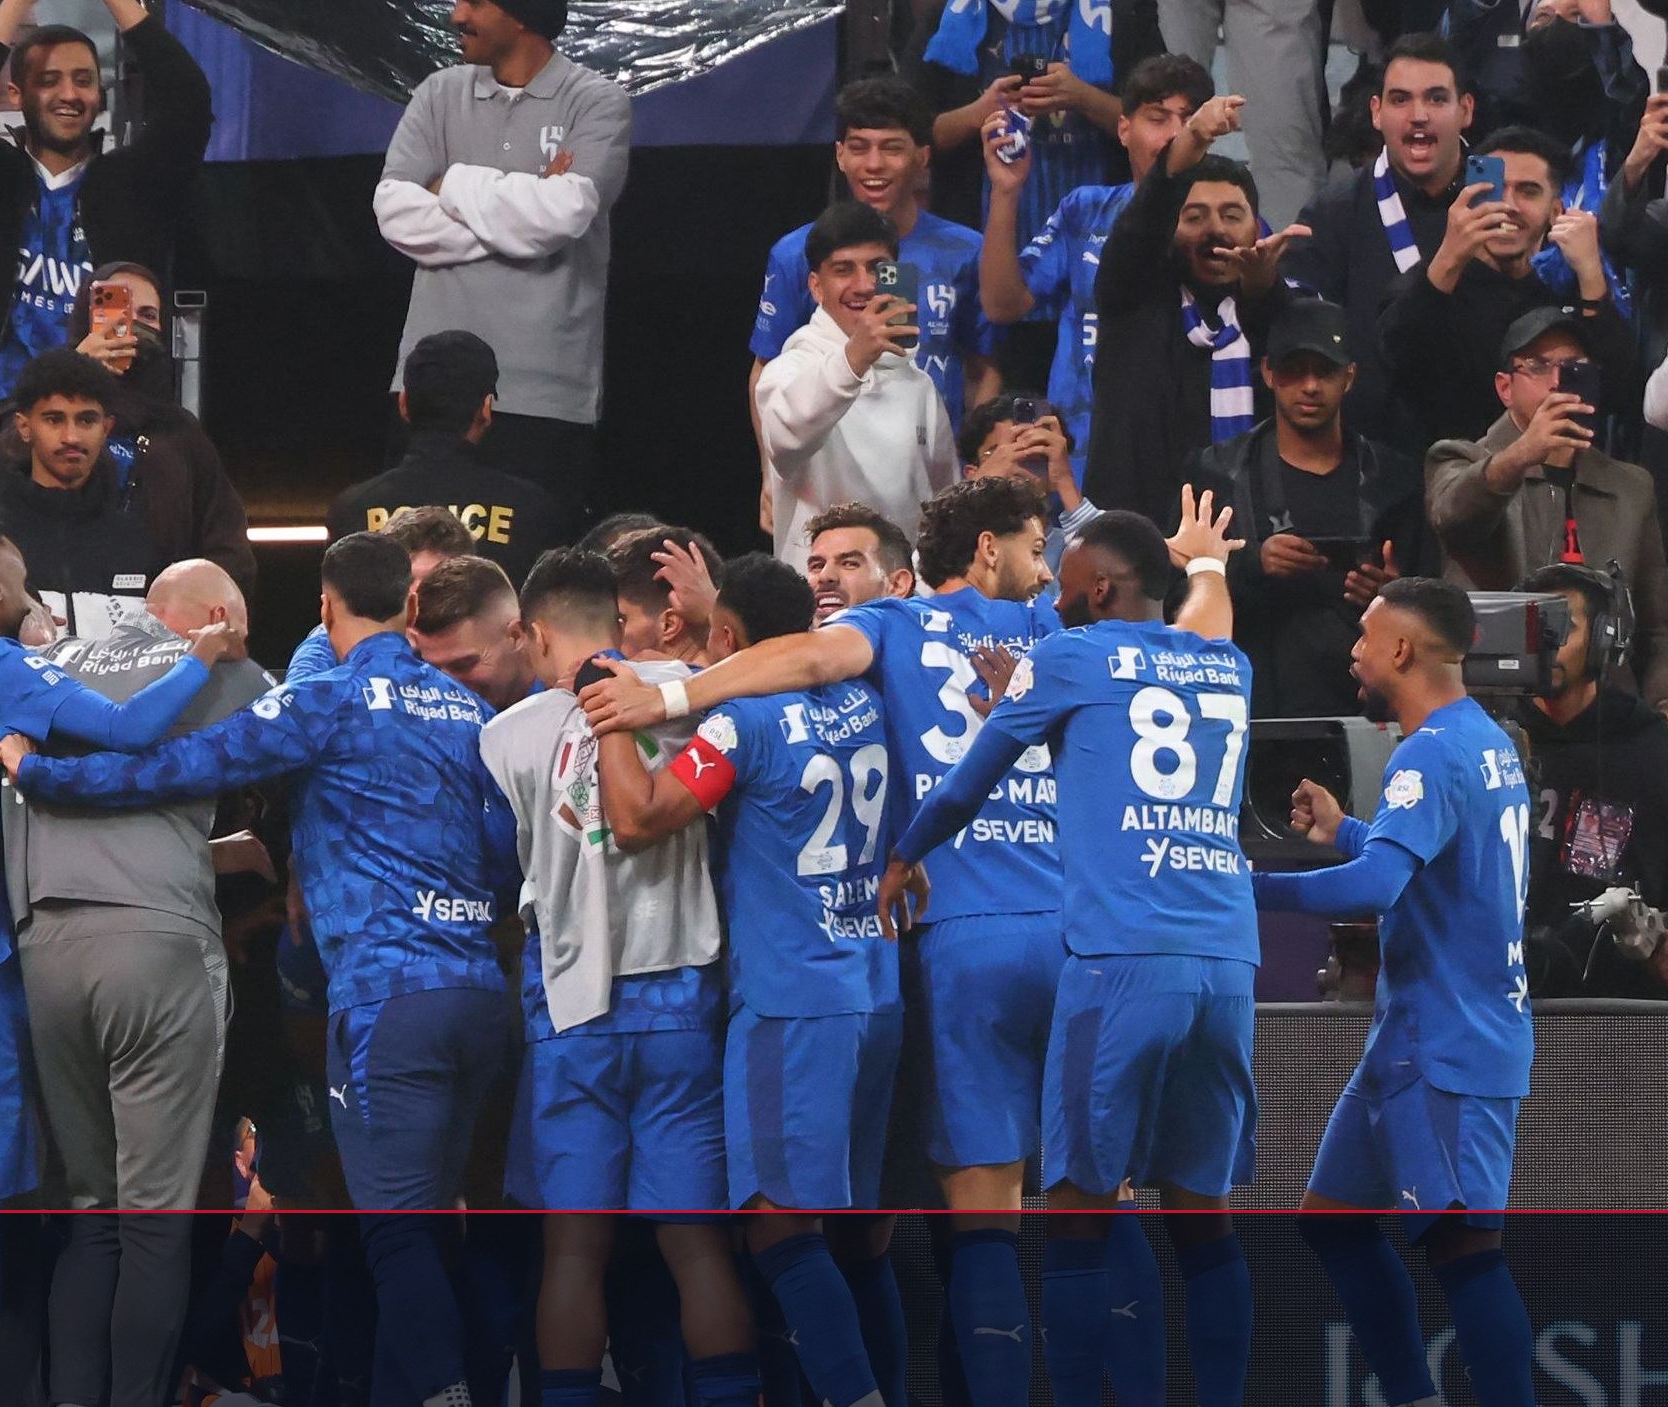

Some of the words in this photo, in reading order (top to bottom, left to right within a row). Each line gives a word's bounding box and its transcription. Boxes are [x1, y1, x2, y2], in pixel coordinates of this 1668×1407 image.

[78, 654, 132, 675] Riyad
[1156, 666, 1204, 686] Riyad
[1205, 669, 1241, 688] Bank
[403, 700, 446, 721] Riyad
[848, 705, 880, 734] Bank
[1128, 685, 1248, 806] 87
[797, 744, 888, 878] 29
[972, 819, 1054, 844] SEVEN
[1169, 845, 1240, 875] SEVEN
[435, 897, 494, 924] SEVEN
